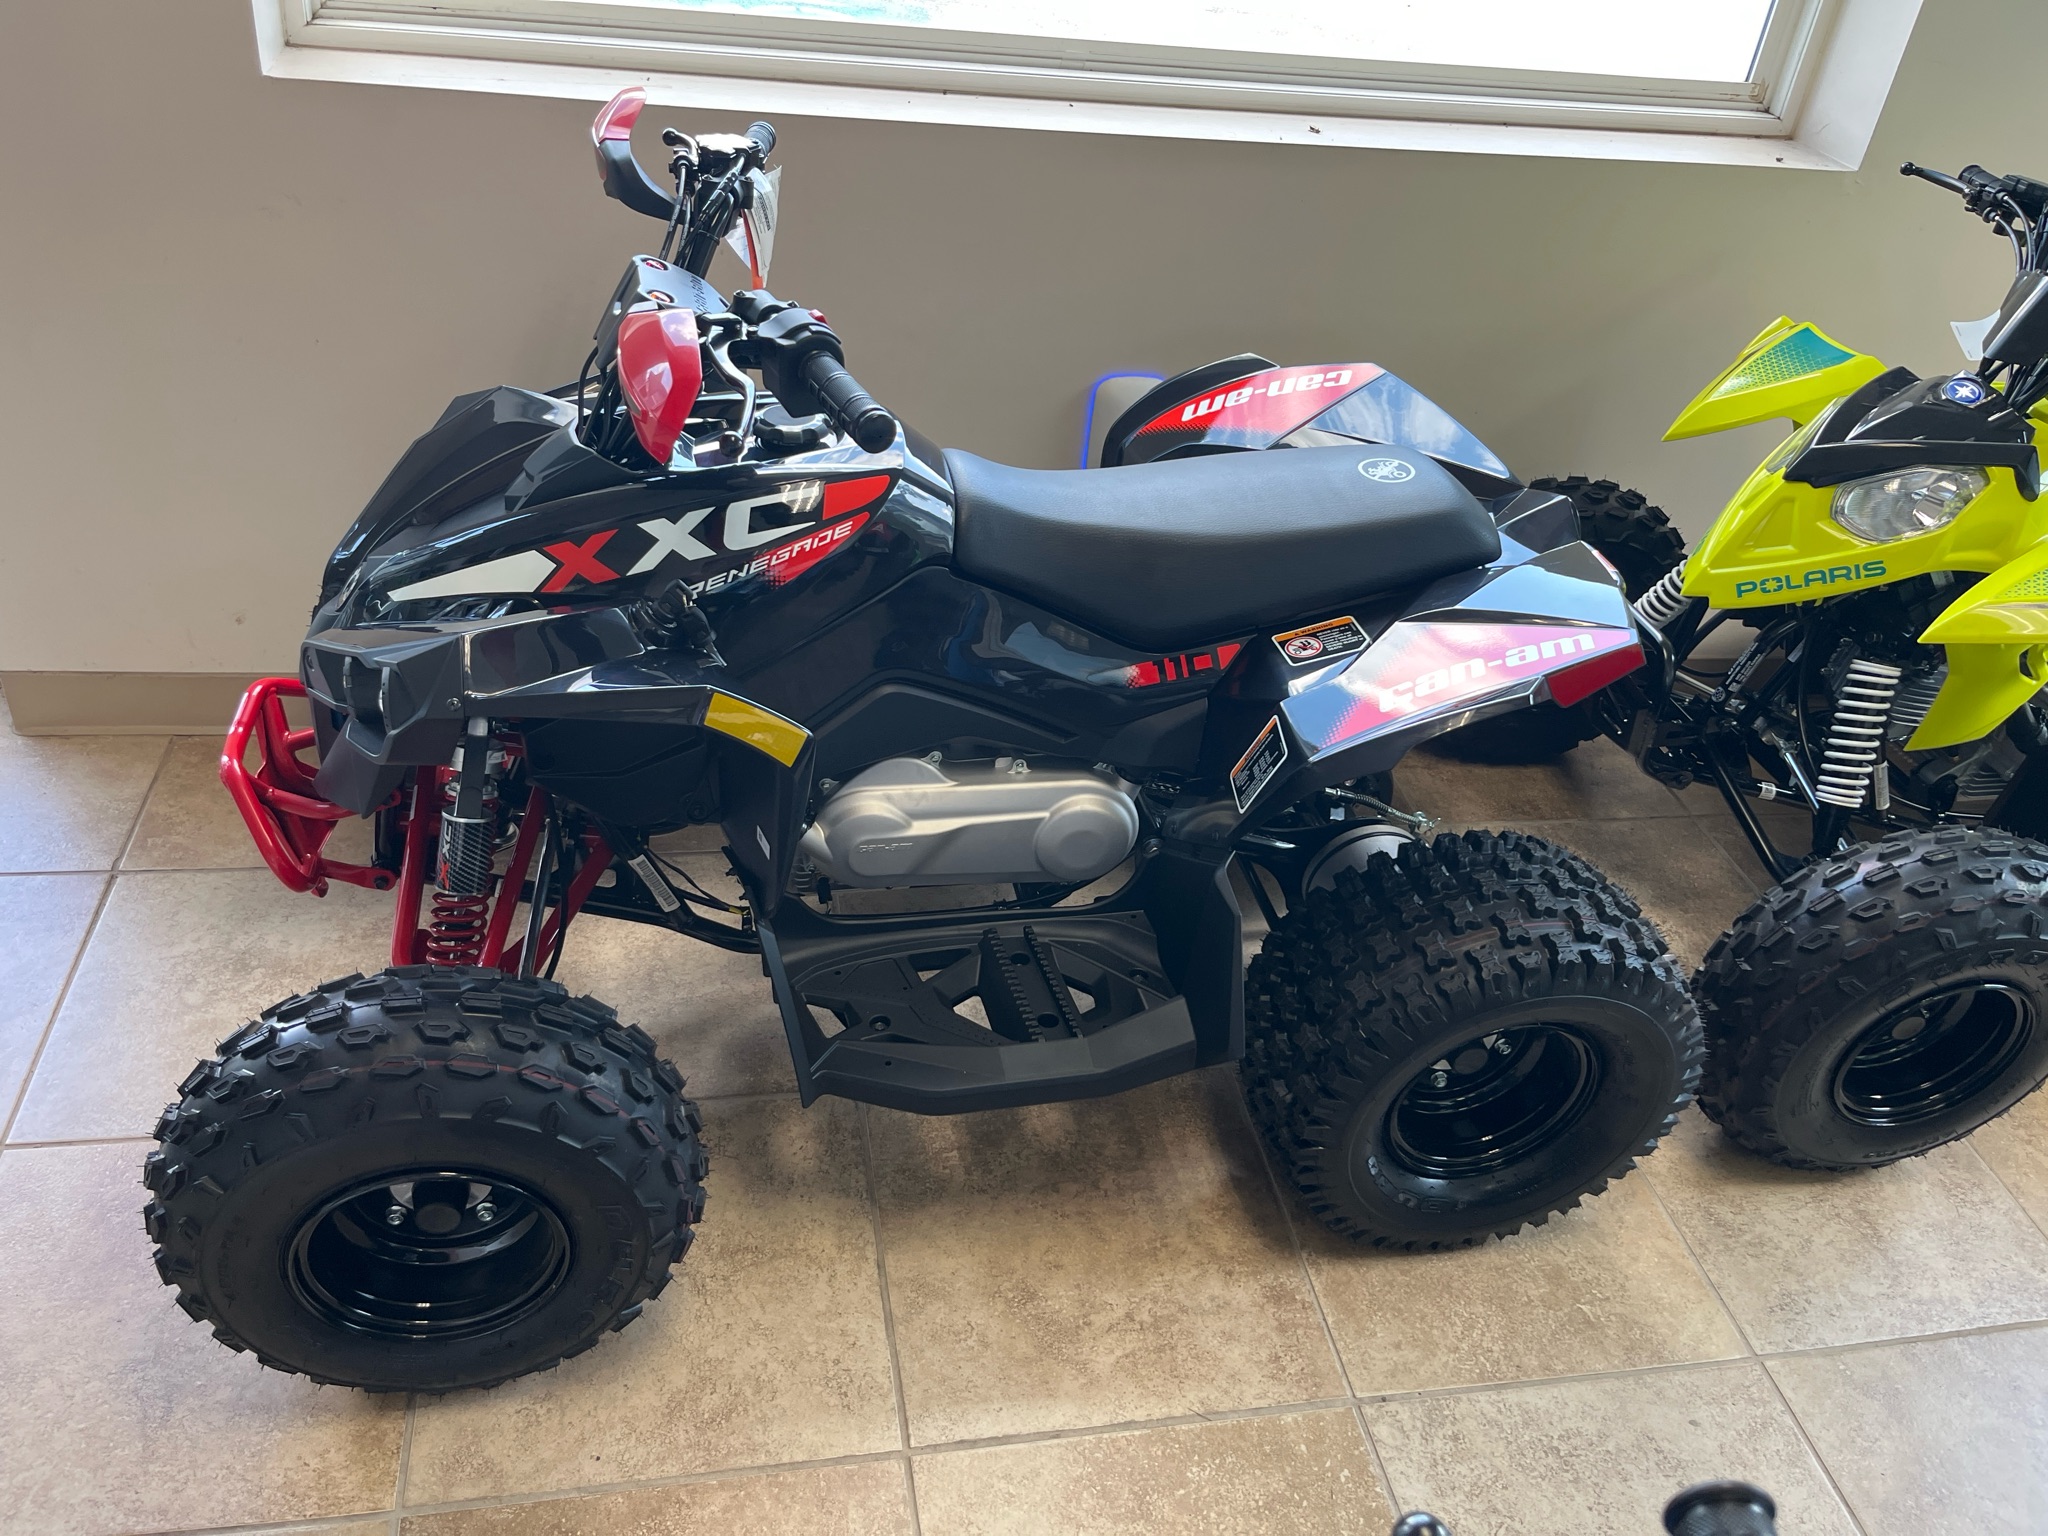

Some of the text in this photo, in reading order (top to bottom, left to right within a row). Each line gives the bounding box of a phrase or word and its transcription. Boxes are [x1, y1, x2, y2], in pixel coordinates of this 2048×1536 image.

[1181, 369, 1353, 422] can-am
[540, 481, 821, 594] XXC
[687, 521, 853, 600] RENEGADE
[1735, 560, 1887, 598] POLARIS
[1379, 633, 1596, 713] can-am
